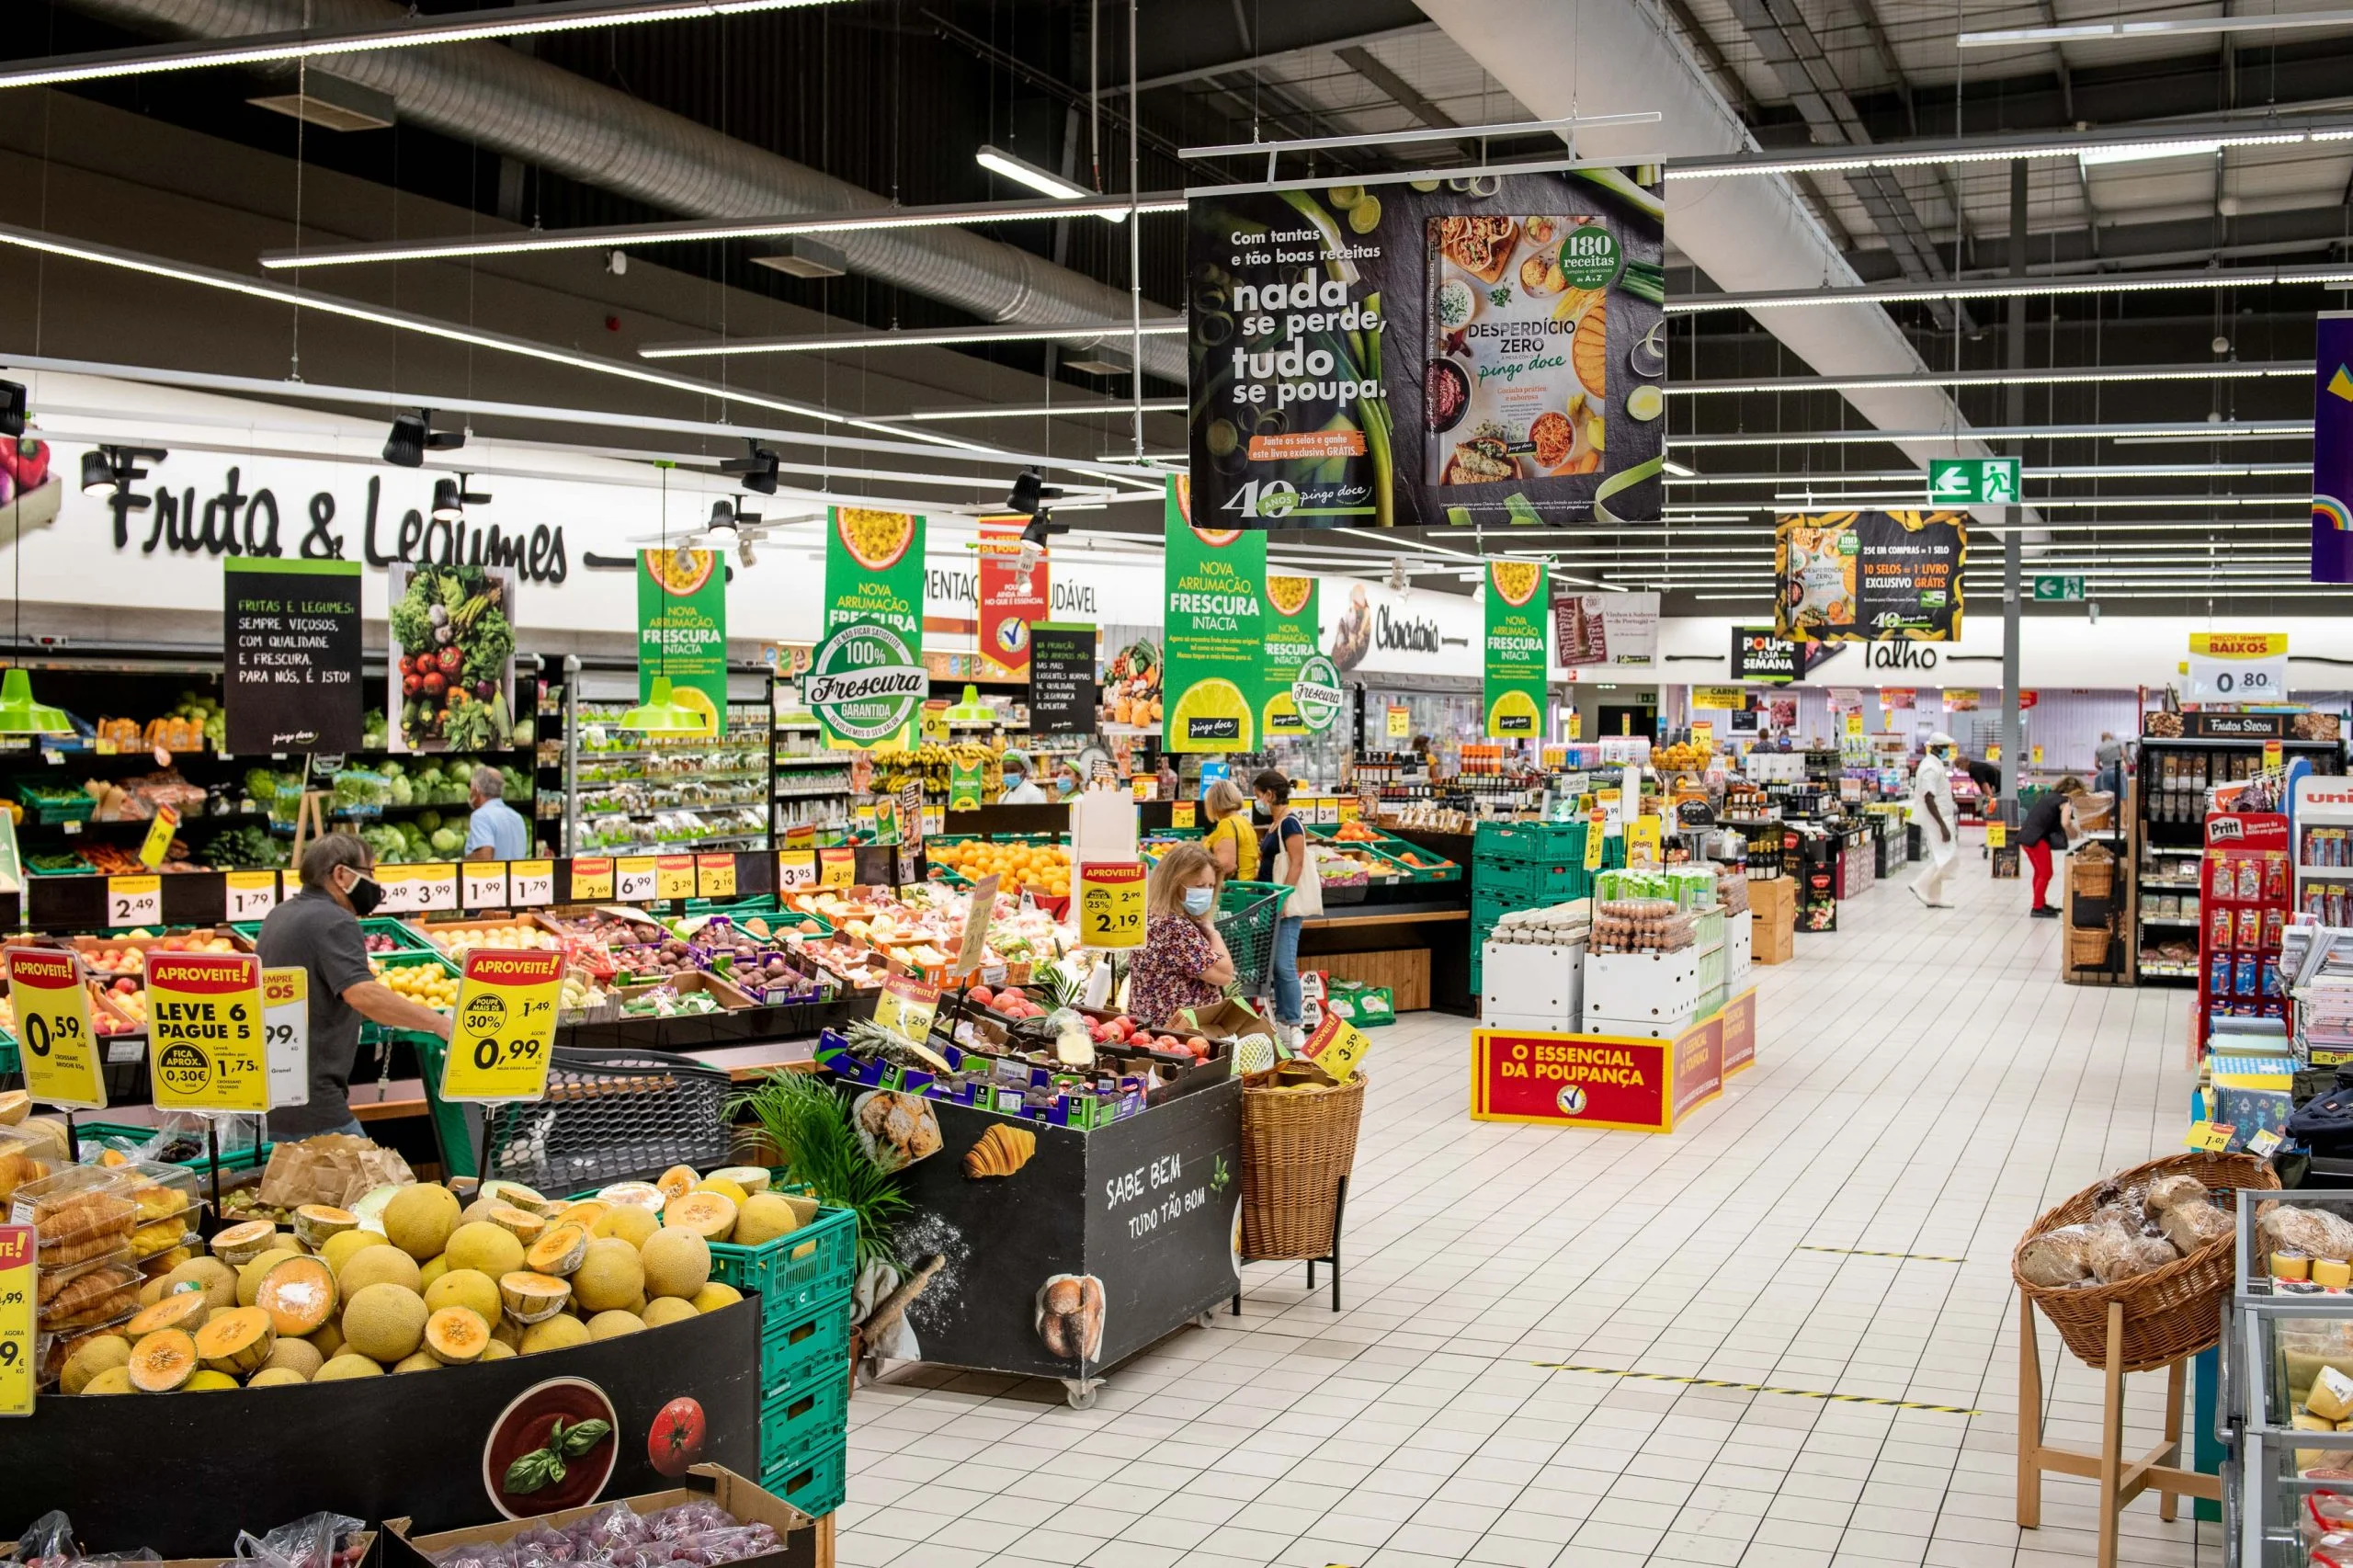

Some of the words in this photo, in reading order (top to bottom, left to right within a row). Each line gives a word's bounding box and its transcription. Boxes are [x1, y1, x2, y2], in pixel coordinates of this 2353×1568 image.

[1231, 231, 1266, 245] Com
[1270, 229, 1321, 243] tantas
[1567, 234, 1611, 257] 180
[1231, 256, 1241, 267] e
[1245, 250, 1271, 266] tão
[1276, 248, 1314, 263] boas
[1320, 244, 1381, 261] receitas
[1563, 255, 1615, 269] receitas
[1233, 267, 1347, 312] nada
[1242, 315, 1276, 335] se
[1287, 302, 1387, 342] perde,
[1468, 317, 1576, 338] DESPERDÍCIO
[1500, 337, 1545, 353] ZERO
[1232, 336, 1335, 380] tudo
[1478, 359, 1523, 388] pingo
[1528, 353, 1566, 370] doce
[1232, 384, 1267, 403] se
[1277, 379, 1388, 410] poupa.
[1262, 437, 1283, 447] Junte
[1296, 435, 1315, 445] selos
[1324, 433, 1347, 447] ganhe
[1252, 450, 1268, 460] este
[1271, 449, 1288, 459] livro
[1290, 449, 1324, 458] exclusivo
[1326, 445, 1358, 457] GRÁTIS.
[1221, 479, 1297, 518] 40
[1264, 495, 1292, 509] ANOS
[1300, 487, 1335, 506] pingo
[1337, 484, 1367, 497] doce
[108, 448, 283, 558] Fruta
[300, 492, 347, 561] &
[1888, 546, 1920, 555] COMPRAS
[1933, 546, 1949, 554] SELO
[1199, 562, 1234, 577] NOVA
[1863, 563, 1874, 574] 10
[1876, 563, 1902, 574] SELOS
[1922, 563, 1949, 574] LIVRO
[858, 583, 892, 597] NOVA
[1177, 576, 1255, 597] ARRUMAÇÃO,
[1865, 577, 1912, 588] EXCLUSIVO
[1914, 575, 1946, 588] GRÁTIS
[238, 599, 281, 613] FRUTAS
[287, 600, 295, 613] E
[301, 601, 355, 615] LEGUMES:
[668, 606, 698, 617] NOVA
[836, 596, 912, 614] ARRUMAÇÃO,
[1169, 593, 1260, 617] FRESCURA
[238, 617, 282, 631] SEMPRE
[289, 619, 339, 632] VIÇOSOS,
[1192, 616, 1238, 631] INTACTA
[1505, 615, 1527, 626] NOVA
[238, 635, 263, 648] COM
[268, 635, 330, 649] QUALIDADE
[642, 629, 722, 643] FRESCURA
[854, 627, 871, 636] FICAR
[871, 627, 901, 649] SATISFEITO
[1487, 636, 1544, 651] FRESCURA
[663, 643, 703, 654] INTACTA
[845, 641, 886, 665] 100%
[1501, 651, 1530, 661] INTACTA
[1757, 651, 1779, 660] ESTA
[2209, 642, 2268, 653] BAIXOS
[238, 653, 247, 665] E
[254, 653, 313, 666] FRESCURA.
[1743, 658, 1794, 670] SEMANA
[238, 670, 269, 684] PARA
[275, 670, 301, 684] NÓS,
[306, 667, 314, 684] É
[321, 671, 351, 684] ISTO!
[811, 673, 923, 703] Frescura
[1294, 684, 1340, 704] Frescura
[1711, 687, 1739, 696] CARNE
[841, 703, 891, 718] GARANTIDA
[830, 715, 865, 737] DEVOLVEMOS
[883, 717, 900, 733] VALOR
[1190, 722, 1213, 737] pingo
[1214, 719, 1233, 730] doce
[2210, 718, 2242, 732] Frutos
[2243, 719, 2272, 733] Secos
[272, 732, 295, 745] pingo
[295, 731, 313, 740] doce
[1563, 778, 1586, 789] Garden
[2211, 821, 2239, 835] Pritt
[1631, 840, 1654, 848] donuts
[784, 869, 811, 886] 3,95
[1086, 864, 1142, 878] APROVEITE!
[471, 881, 501, 901] 1,99
[517, 881, 548, 899] 1,79
[621, 876, 652, 894] 6,99
[418, 884, 451, 904] 3,99
[116, 898, 154, 919] 2,49
[234, 893, 269, 913] 1,79
[14, 958, 74, 981] APROVEITE!
[155, 960, 251, 984] APROVEITE!
[473, 954, 558, 976] APROVEITE!
[888, 980, 940, 1000] APROVEITE!
[155, 1002, 216, 1021] LEVE
[229, 1004, 247, 1022] 6
[466, 1015, 501, 1028] 30%
[158, 1023, 229, 1040] PAGUE
[237, 1025, 251, 1040] 5
[1306, 1013, 1338, 1056] APROVEITE!
[1686, 1030, 1708, 1056] ESSENCIAL
[166, 1058, 202, 1067] APROX.
[173, 1050, 193, 1059] FICA
[1511, 1043, 1529, 1062] O
[1535, 1045, 1635, 1068] ESSENCIAL
[165, 1070, 207, 1084] 0,30€
[1501, 1062, 1529, 1079] DA
[1535, 1063, 1645, 1089] POUPANÇA
[1105, 1166, 1146, 1211] SABE
[1150, 1152, 1182, 1190] BEM
[1128, 1208, 1158, 1239] TUDO
[1160, 1191, 1182, 1224] TÃO
[1184, 1187, 1206, 1215] BOM
